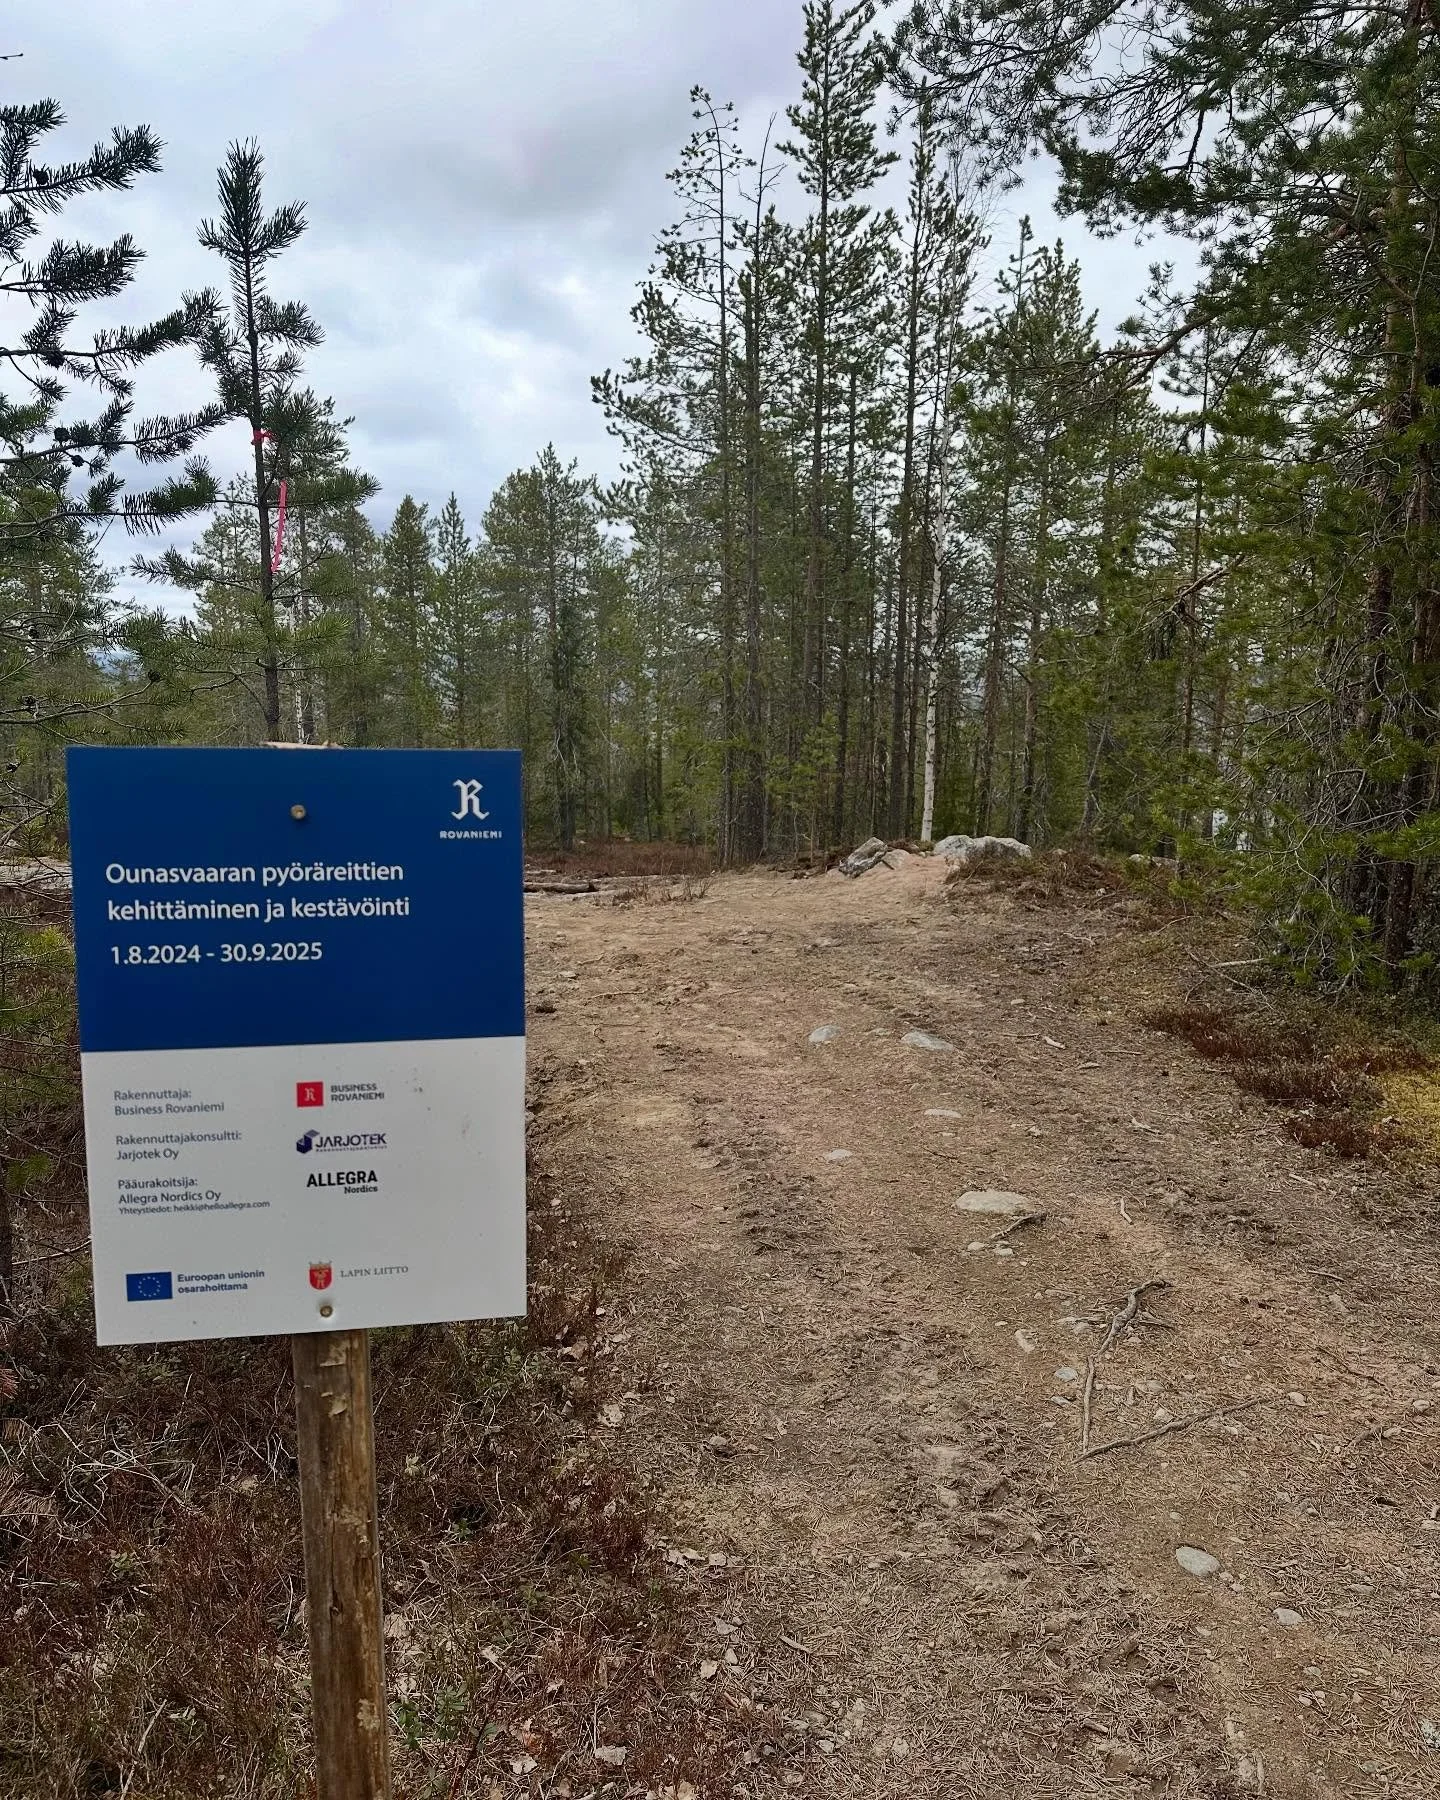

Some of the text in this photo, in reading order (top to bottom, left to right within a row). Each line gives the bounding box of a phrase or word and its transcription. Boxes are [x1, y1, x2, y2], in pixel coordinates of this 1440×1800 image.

[439, 830, 503, 840] ROVANIEMI
[105, 862, 404, 887] Ounasvaaran pyöräreittien
[107, 897, 410, 923] kehittäminen ja kestävöinti
[111, 944, 201, 965] 1.8.2024
[220, 941, 323, 963] 30.9.2025
[113, 1088, 192, 1102] Rakennuttaja:
[330, 1083, 378, 1093] BUSINESS
[330, 1092, 385, 1102] ROVANIEMI
[114, 1101, 225, 1117] Business Rovaniemi
[115, 1130, 242, 1146] Rakennuttajakonsultti:
[315, 1133, 387, 1149] JARJOTEK
[116, 1147, 180, 1162] Jarjotek Oy
[117, 1177, 199, 1190] Pääurakoitsija:
[306, 1170, 379, 1188] ALLEGRA
[343, 1184, 379, 1195] Nordics
[118, 1189, 222, 1206] Allegra Nordics Oy
[118, 1200, 271, 1216] Yhteystiedot: heikki@helloallegra.com
[177, 1269, 265, 1283] Euroopan unionin
[340, 1265, 409, 1278] LAPIN LIITTO
[177, 1282, 249, 1294] osarahoittama
